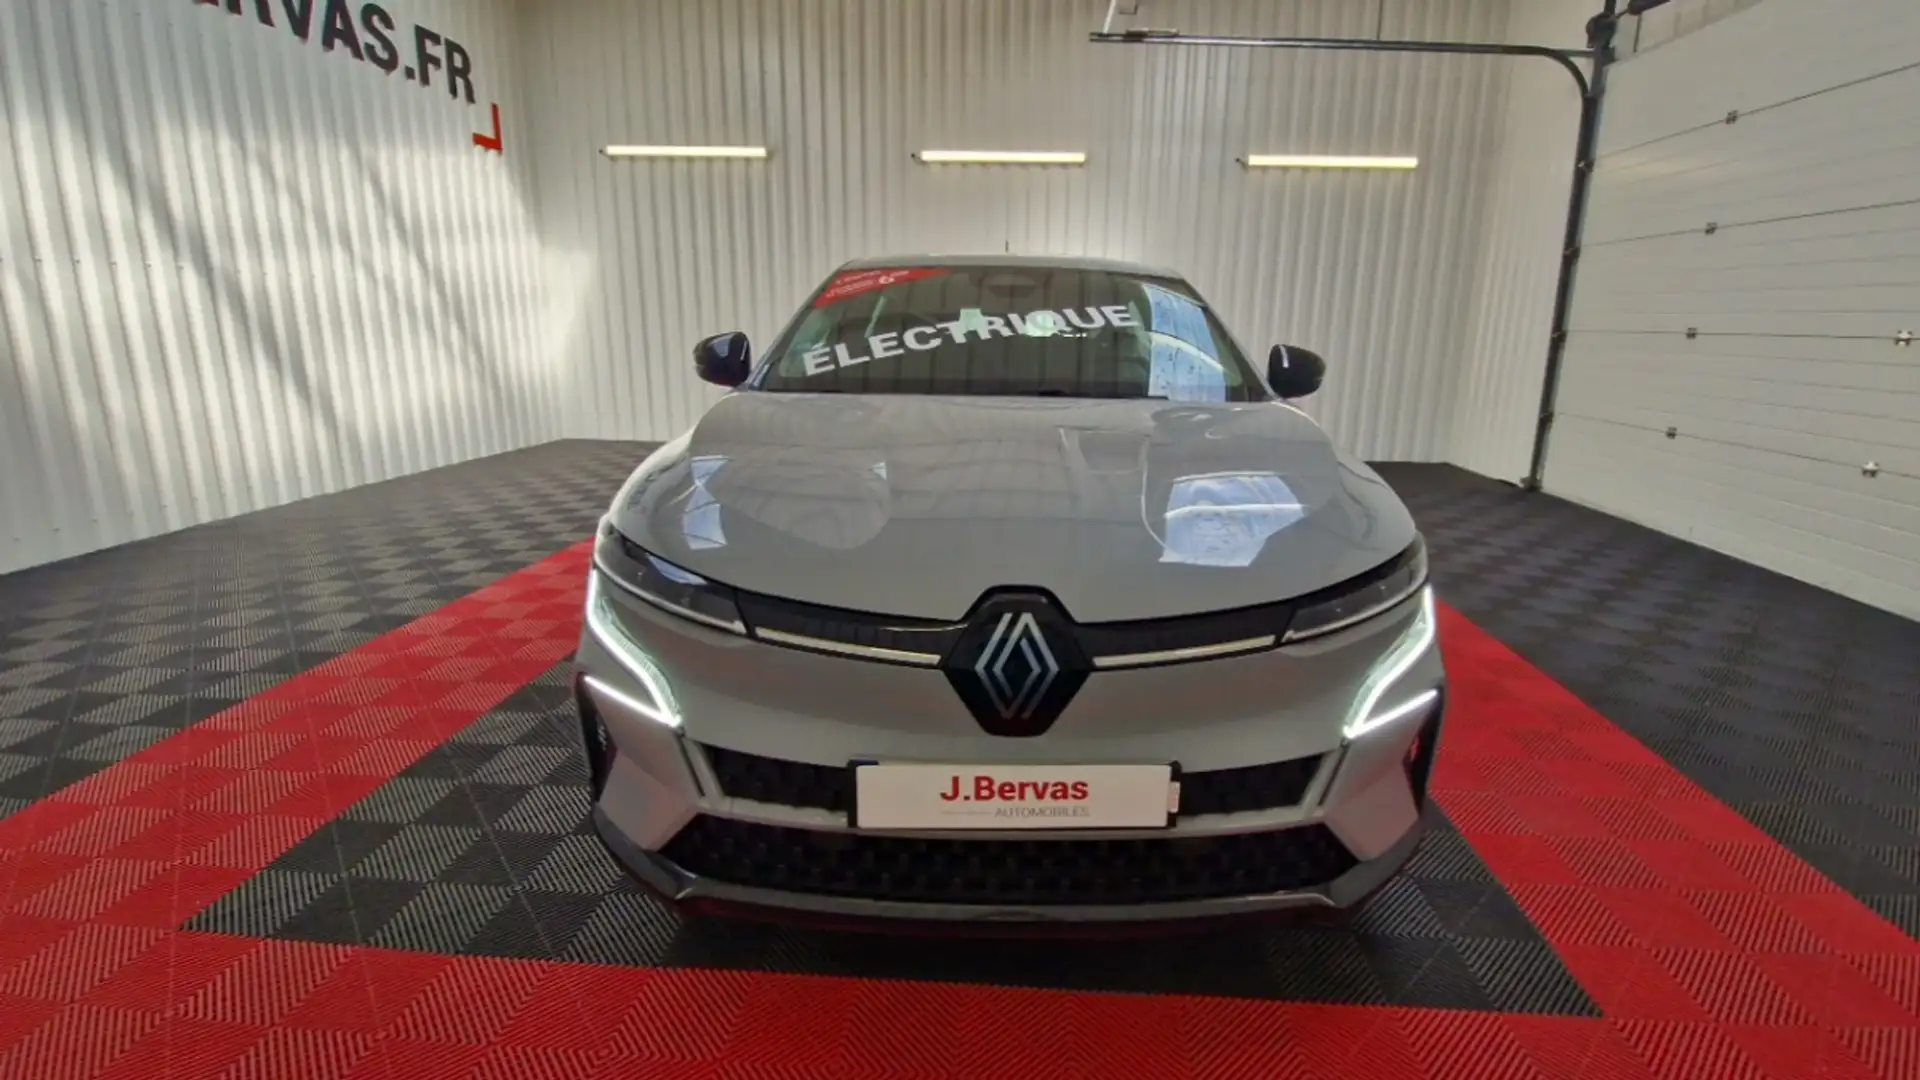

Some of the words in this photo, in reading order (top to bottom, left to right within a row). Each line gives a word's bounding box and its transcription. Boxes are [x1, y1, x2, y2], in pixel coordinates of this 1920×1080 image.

[802, 305, 1141, 376] ÉLECTRIQUE
[940, 775, 1089, 801] J.Bervas
[994, 806, 1090, 819] AUTOMOBILES
